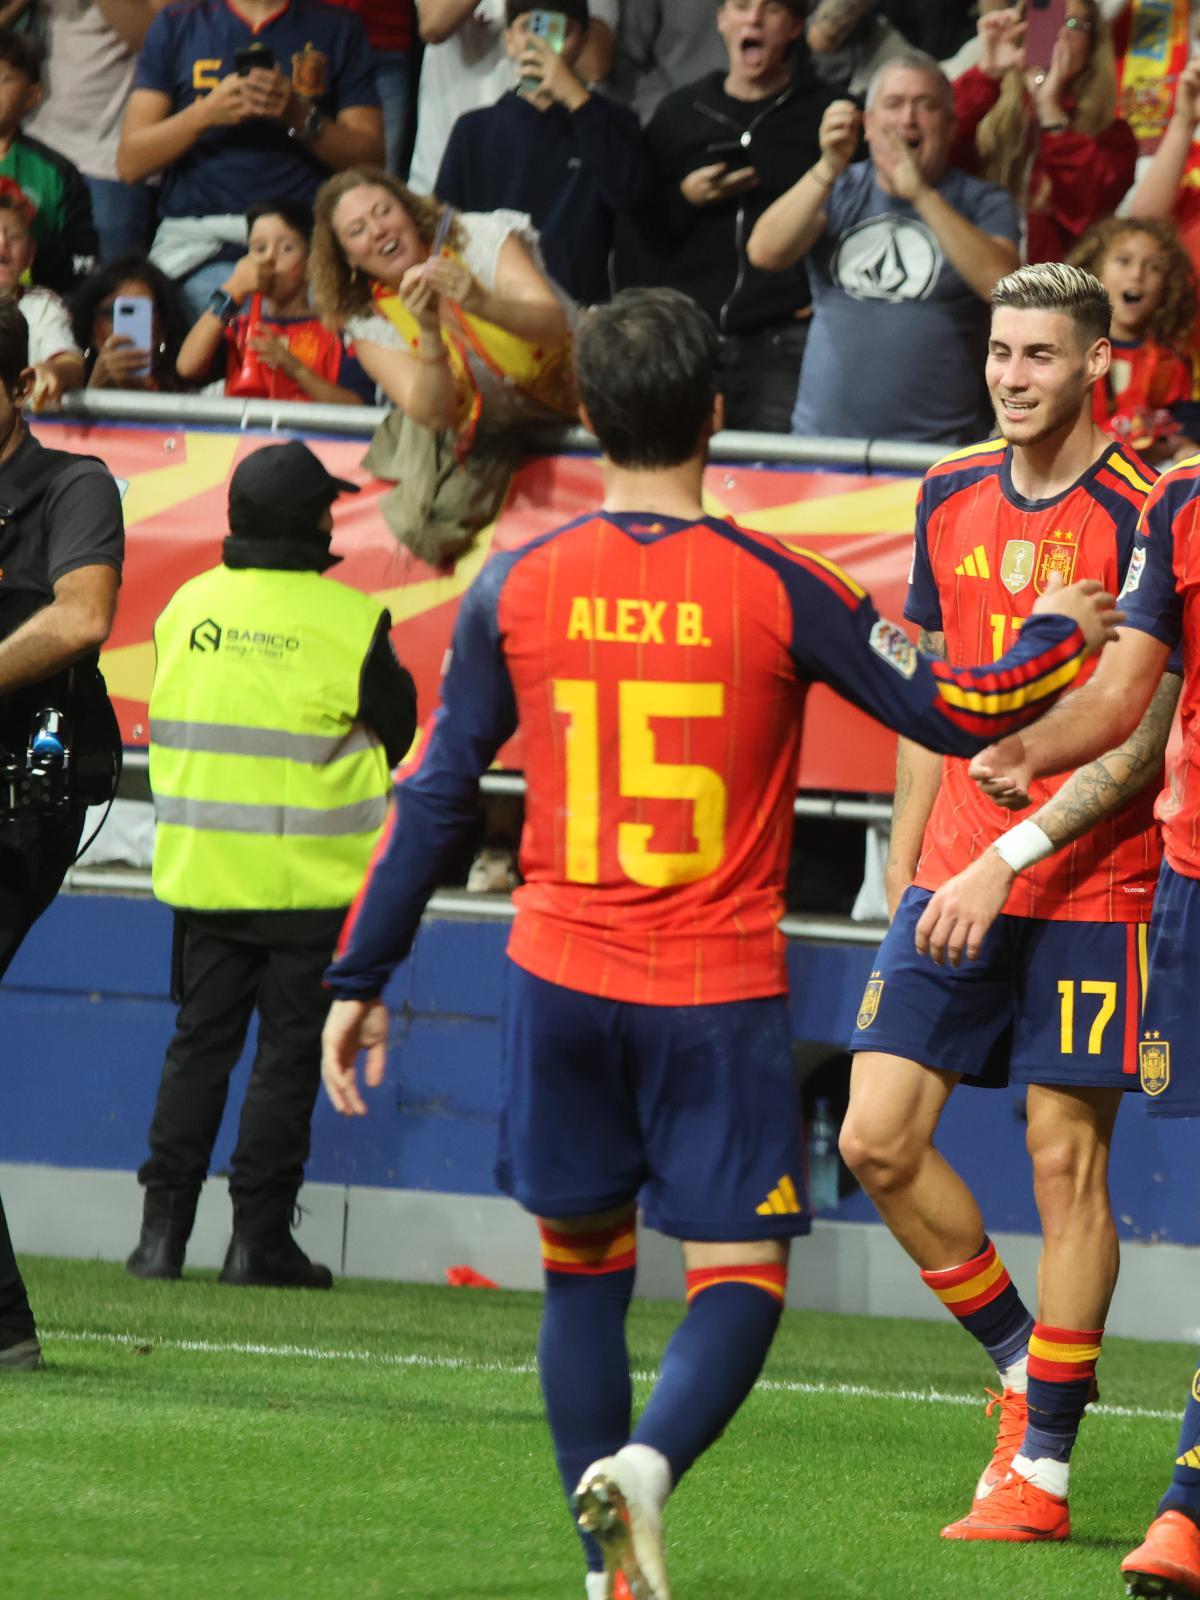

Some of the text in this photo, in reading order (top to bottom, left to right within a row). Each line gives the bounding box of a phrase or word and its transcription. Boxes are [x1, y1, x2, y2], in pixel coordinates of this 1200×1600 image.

[567, 597, 712, 646] ALEX B.
[552, 678, 726, 888] 15
[1057, 980, 1117, 1055] 17
